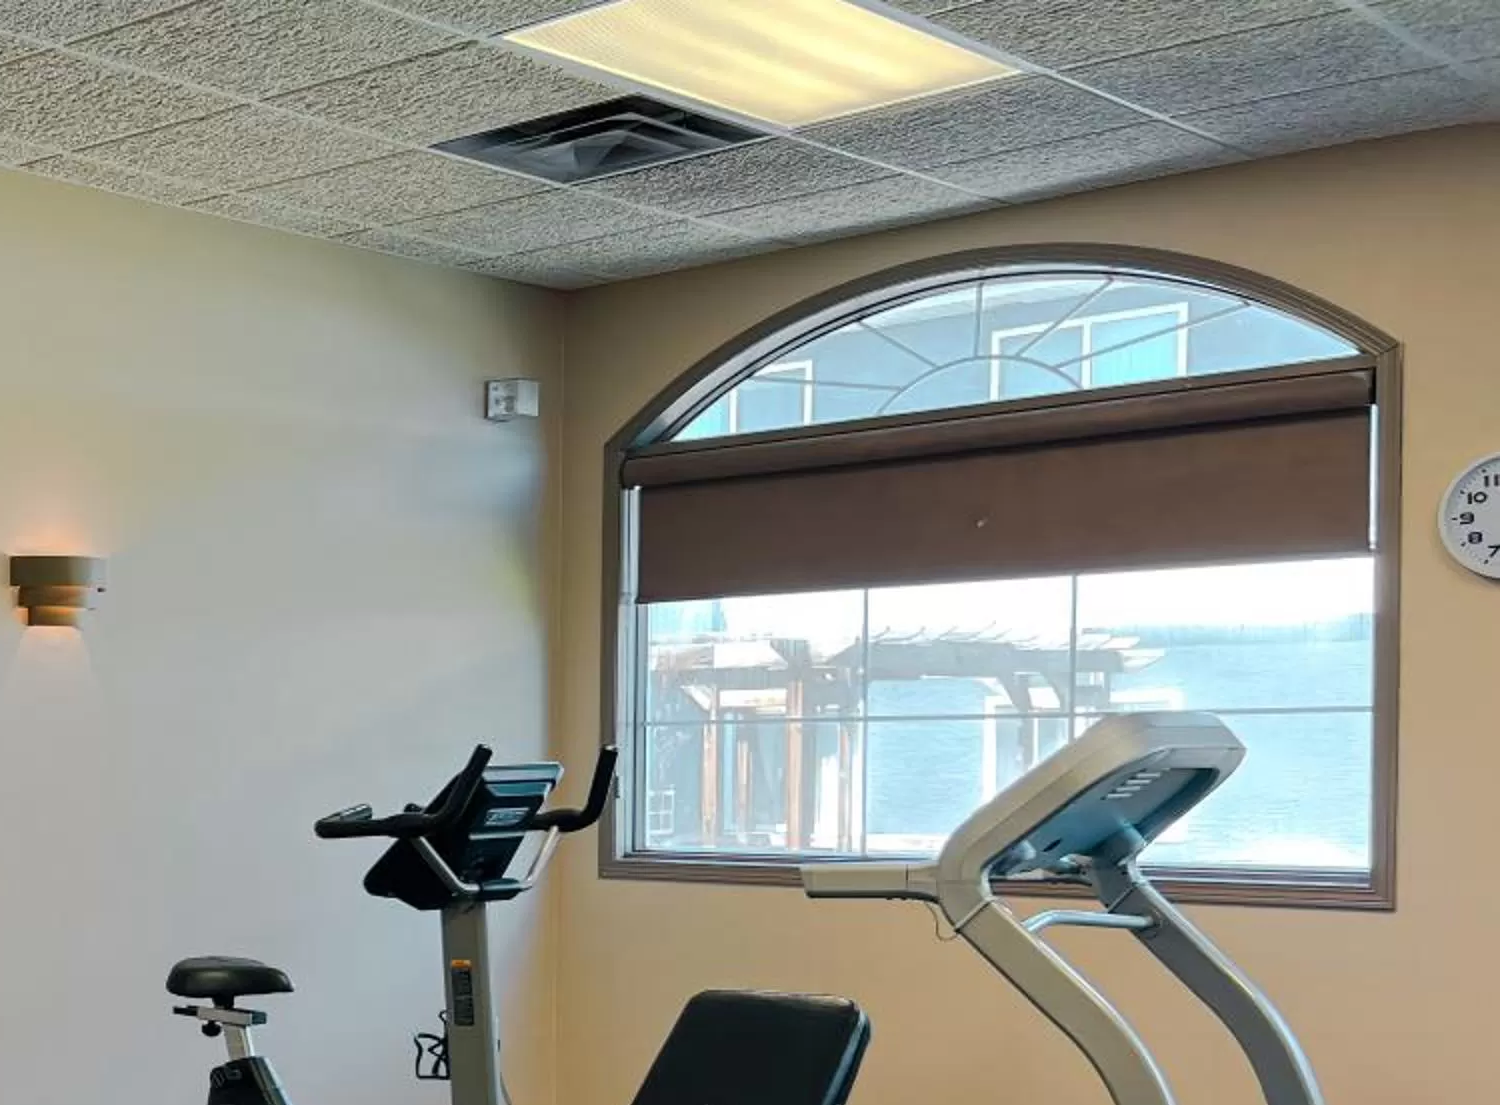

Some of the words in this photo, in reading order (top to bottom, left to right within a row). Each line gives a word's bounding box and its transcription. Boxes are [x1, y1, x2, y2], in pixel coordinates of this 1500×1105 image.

[1467, 491, 1488, 504] 10
[1459, 511, 1475, 525] 9
[1467, 531, 1483, 545] 8
